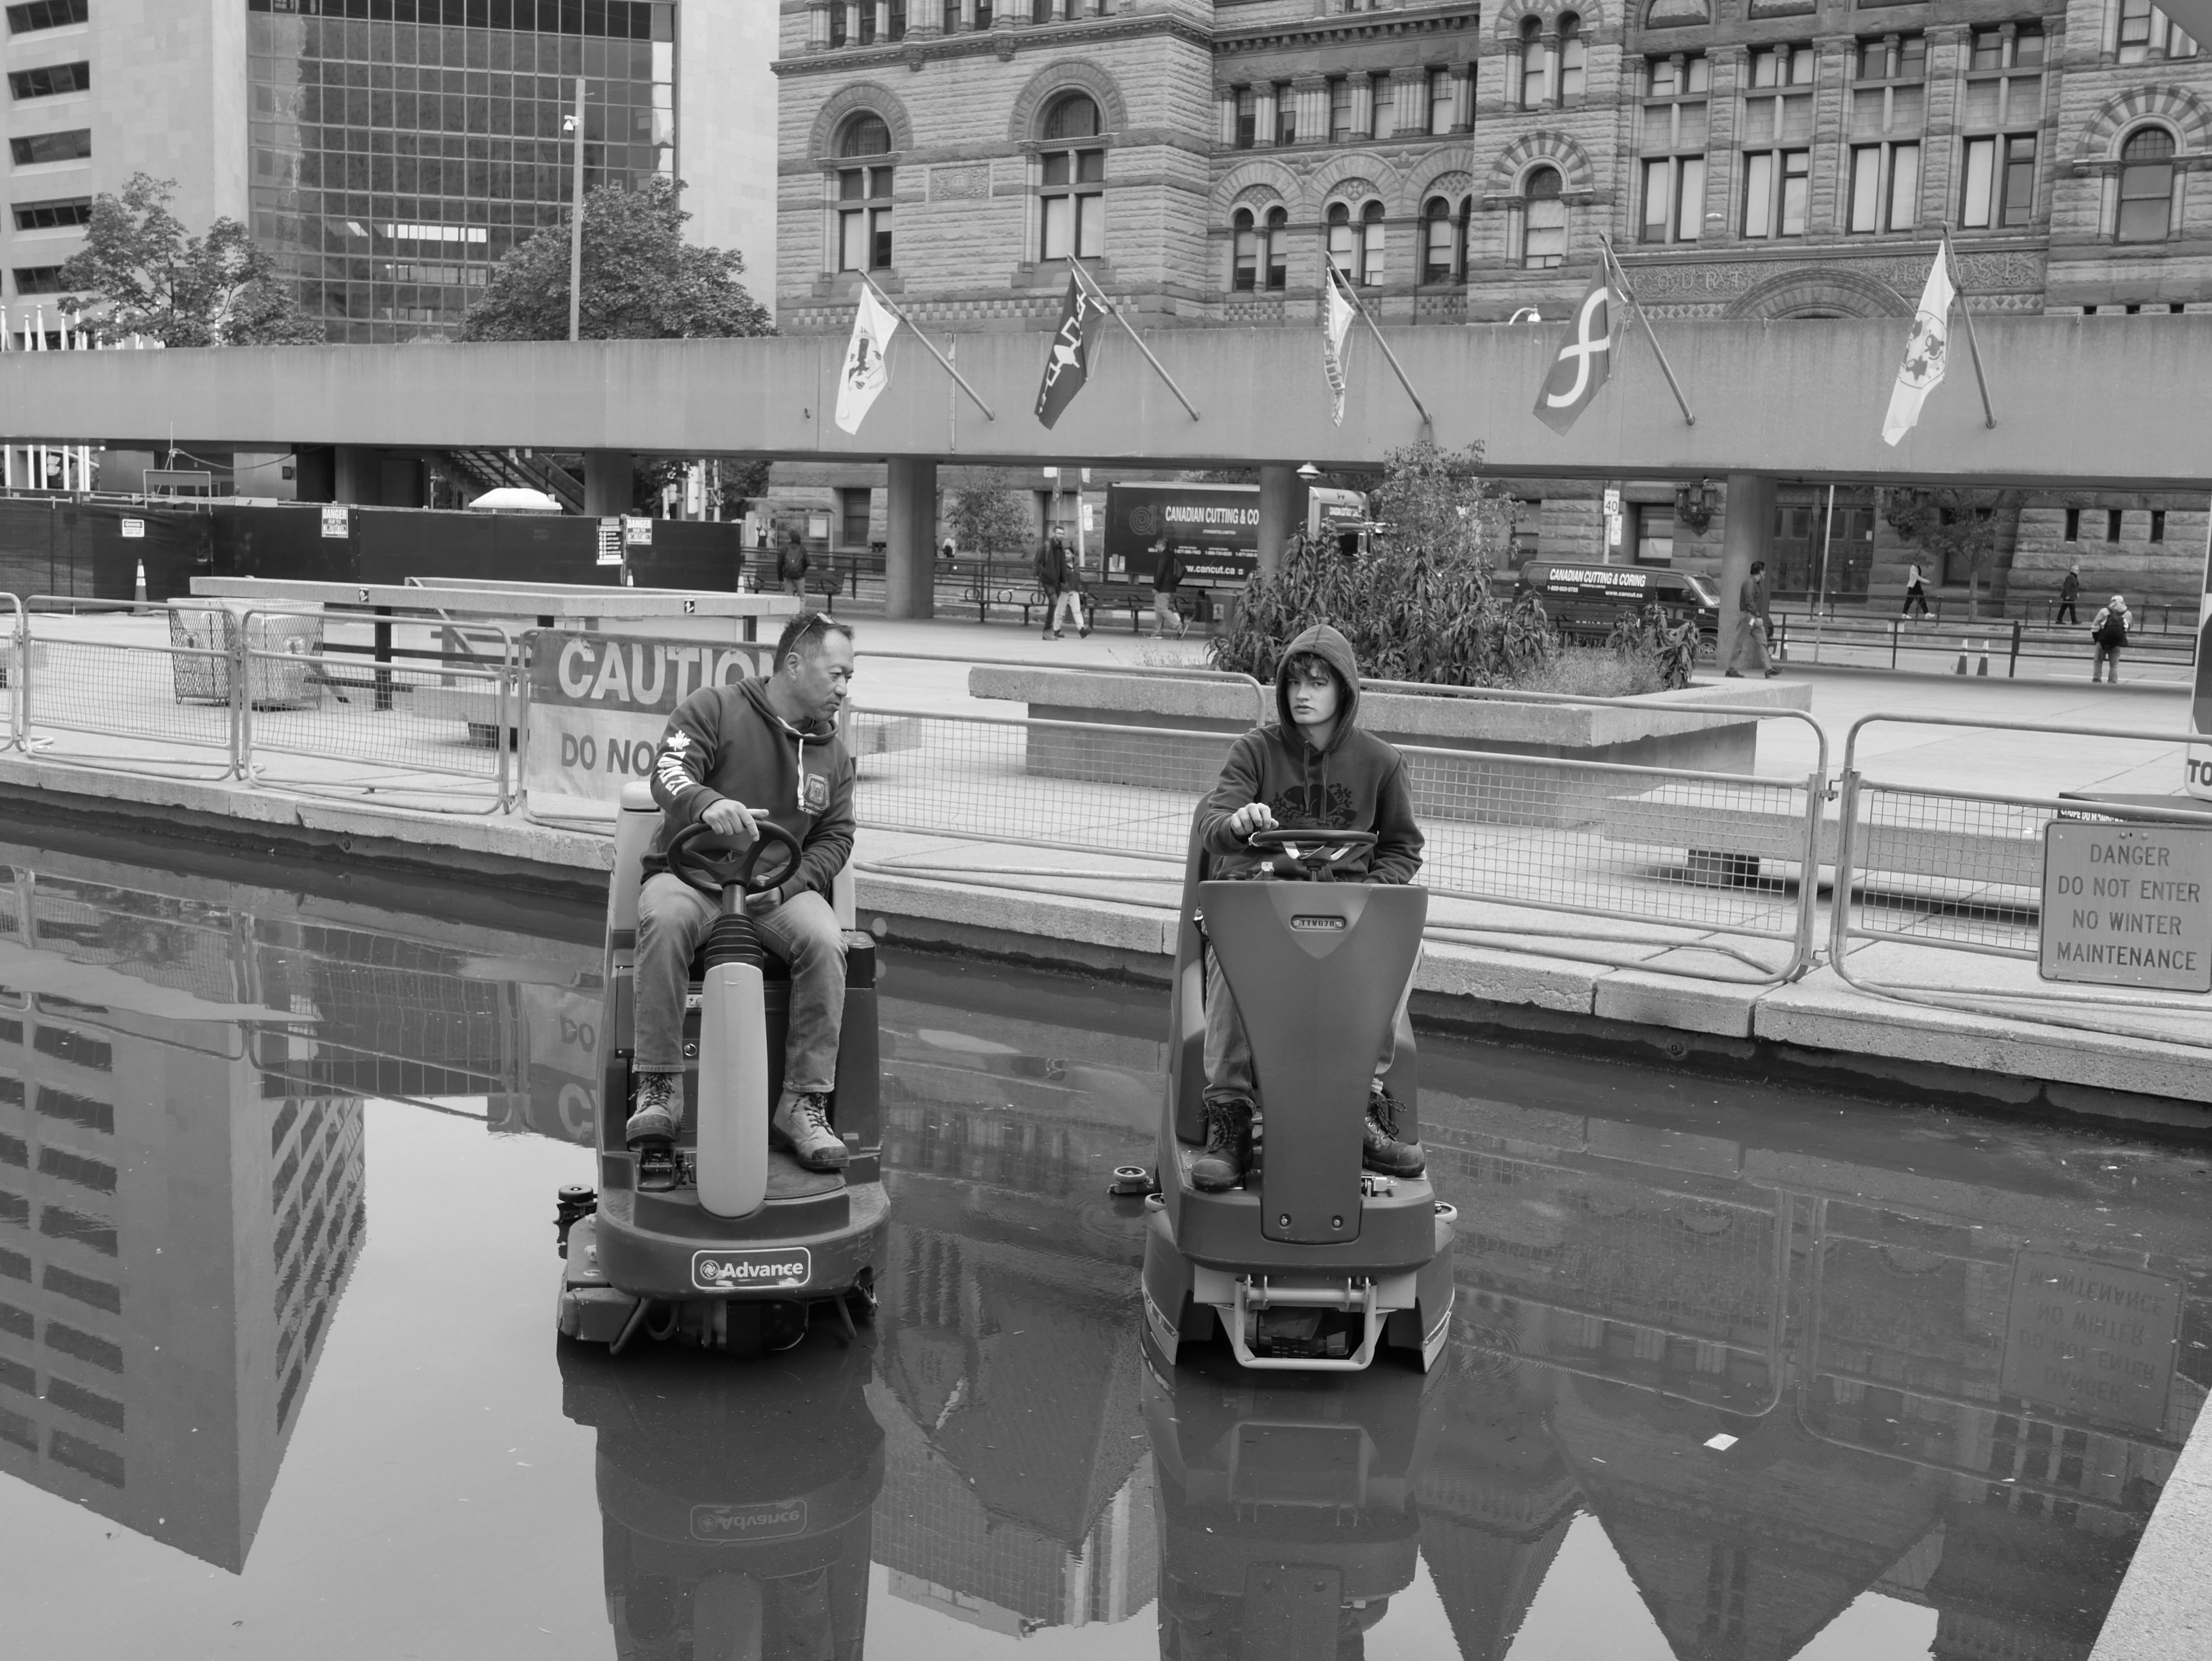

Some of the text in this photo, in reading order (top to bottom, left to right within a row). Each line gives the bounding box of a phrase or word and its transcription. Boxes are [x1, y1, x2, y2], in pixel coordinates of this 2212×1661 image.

[1634, 271, 1745, 291] COURT
[323, 508, 346, 520] DANGER
[1165, 506, 1259, 525] CANADIAN CUTTING & CO
[1605, 501, 1618, 512] 40
[627, 519, 651, 529] DANGER
[1550, 568, 1646, 587] CANADIAN CUTTING & CORING
[559, 638, 774, 706] CAUTIO
[561, 732, 597, 770] DO
[606, 738, 660, 776] NO
[2090, 843, 2170, 867] DANGER
[2058, 875, 2200, 903] DO NOT ENTER
[2073, 909, 2182, 935] NO WINTER
[2057, 941, 2197, 971] MAINTENANCE
[722, 1262, 804, 1277] Advance
